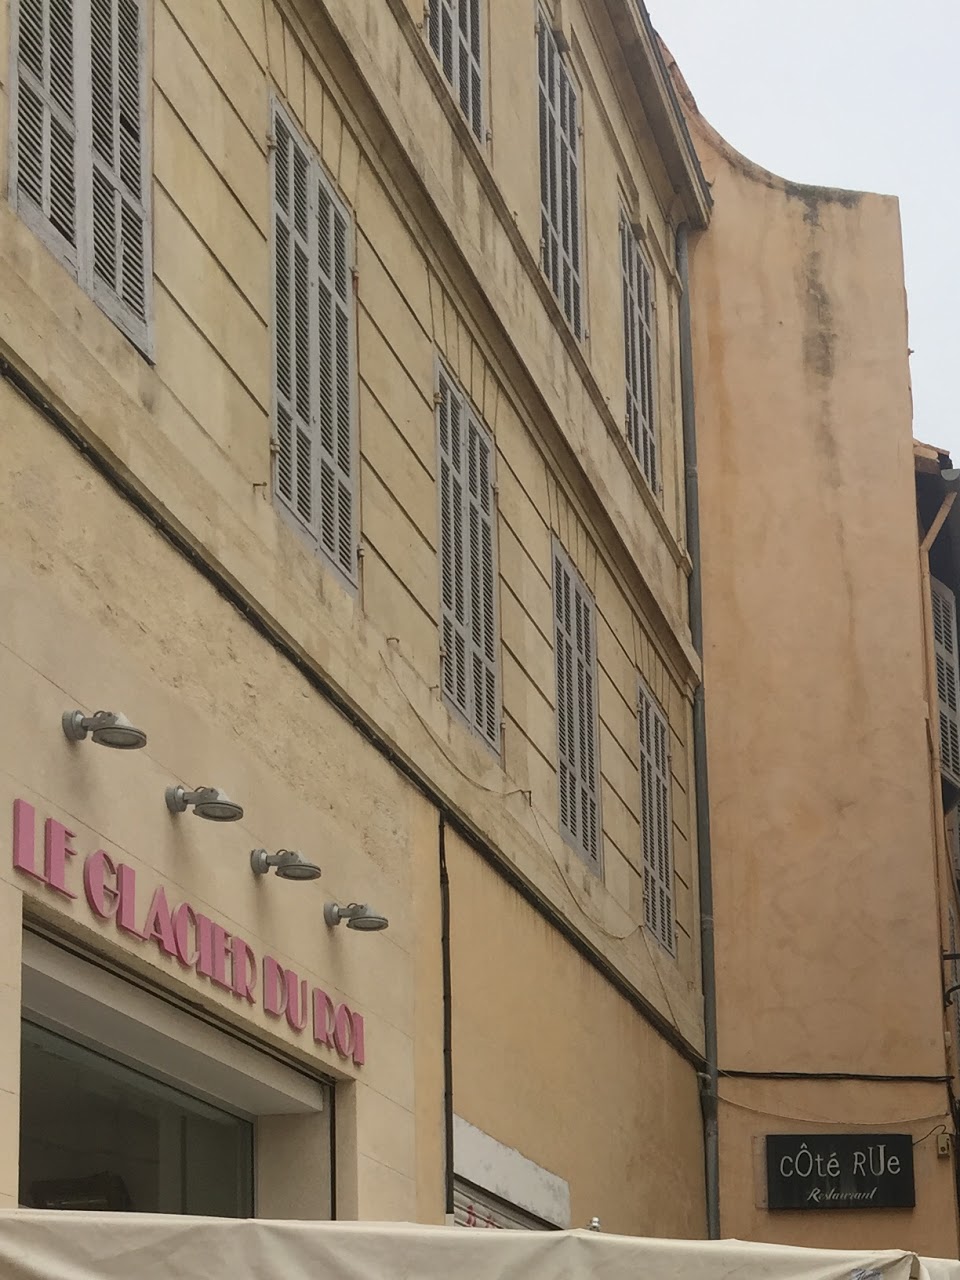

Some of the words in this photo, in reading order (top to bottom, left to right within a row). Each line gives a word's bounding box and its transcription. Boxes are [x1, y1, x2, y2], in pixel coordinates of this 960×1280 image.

[13, 798, 78, 900] LE
[83, 849, 257, 1004] GLACIER
[262, 955, 308, 1031] DU
[313, 987, 365, 1066] ROI
[807, 1187, 878, 1203] Restaurant
